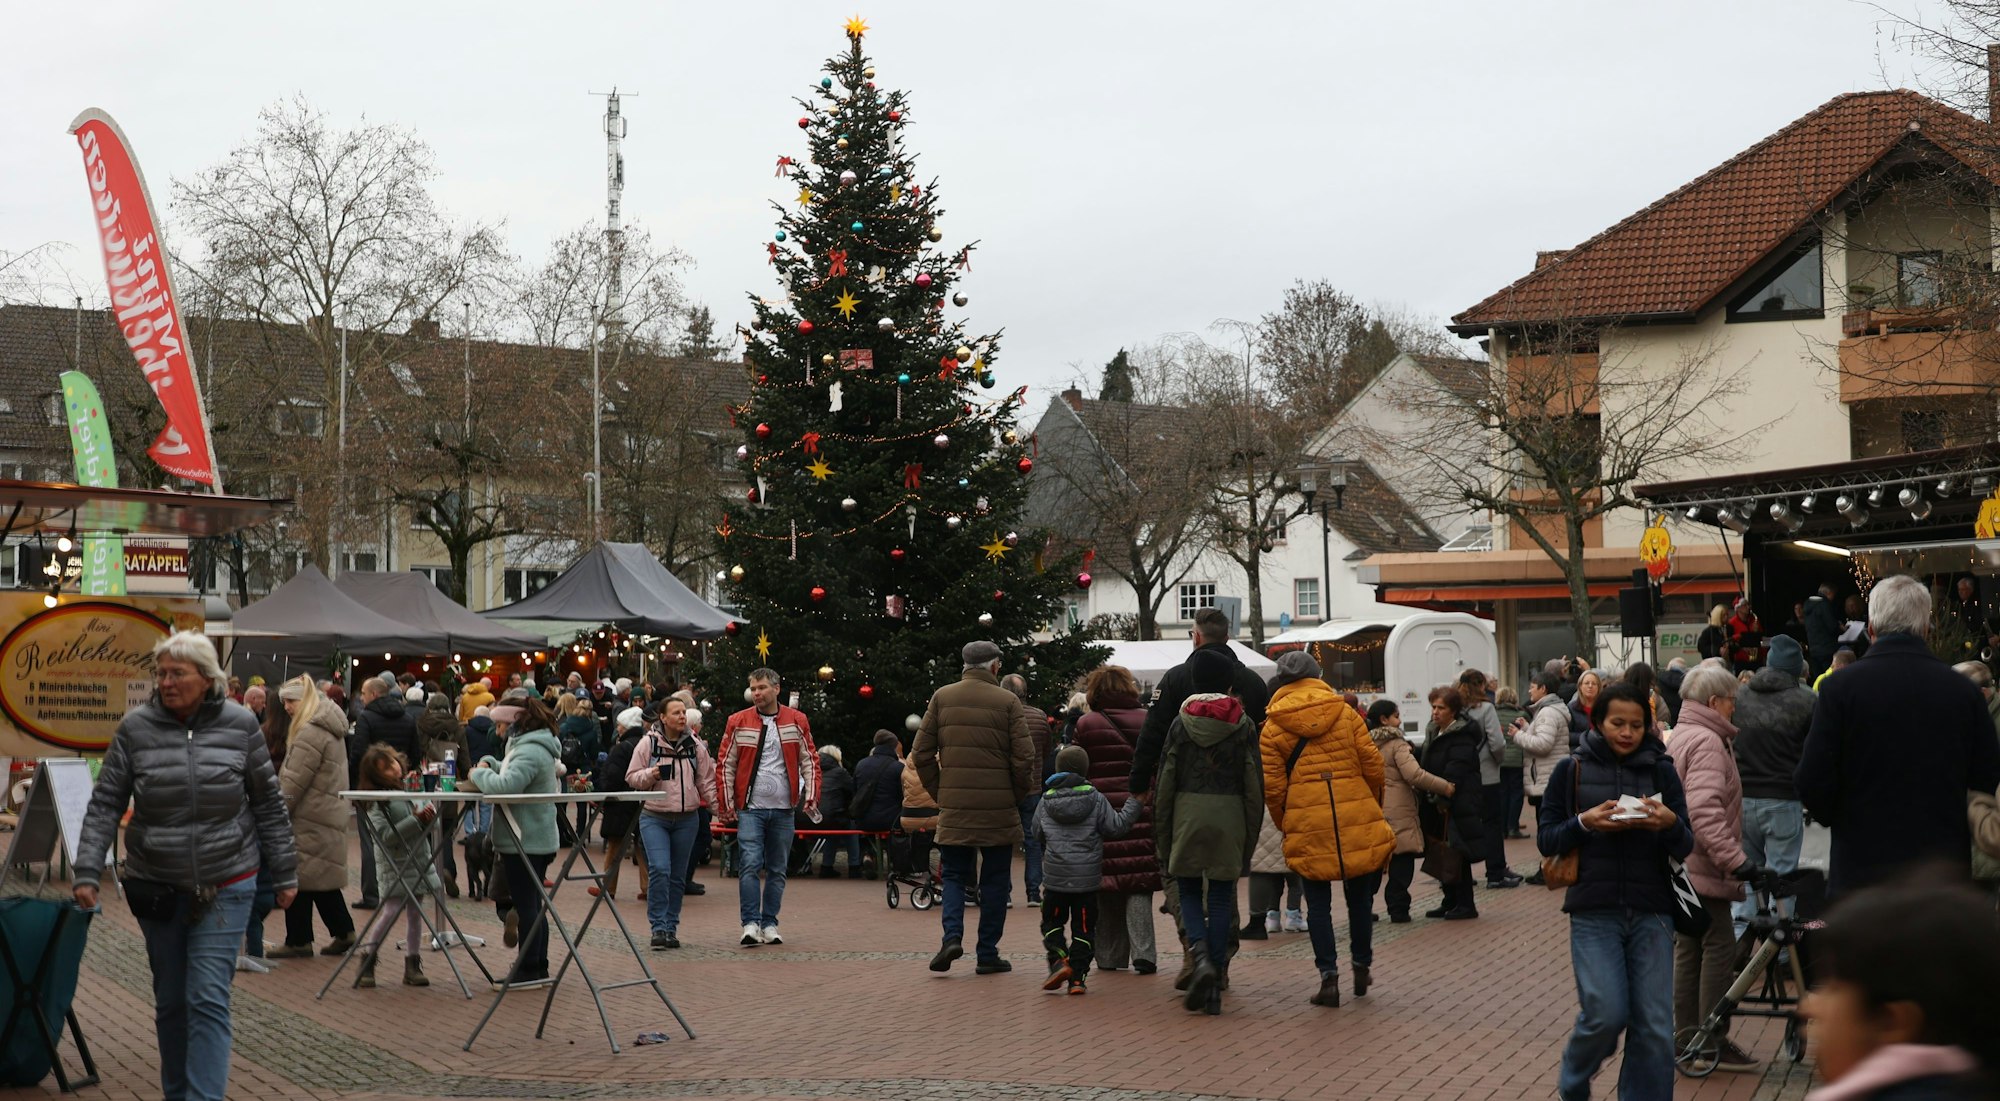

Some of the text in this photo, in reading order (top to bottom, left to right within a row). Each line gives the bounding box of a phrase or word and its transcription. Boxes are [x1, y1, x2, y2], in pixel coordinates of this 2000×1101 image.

[124, 552, 188, 573] RATÄPFEL
[83, 618, 113, 633] Mini
[39, 682, 107, 694] Minireibekuchen
[25, 696, 34, 706] 10
[38, 696, 107, 707] Minireibekuchen
